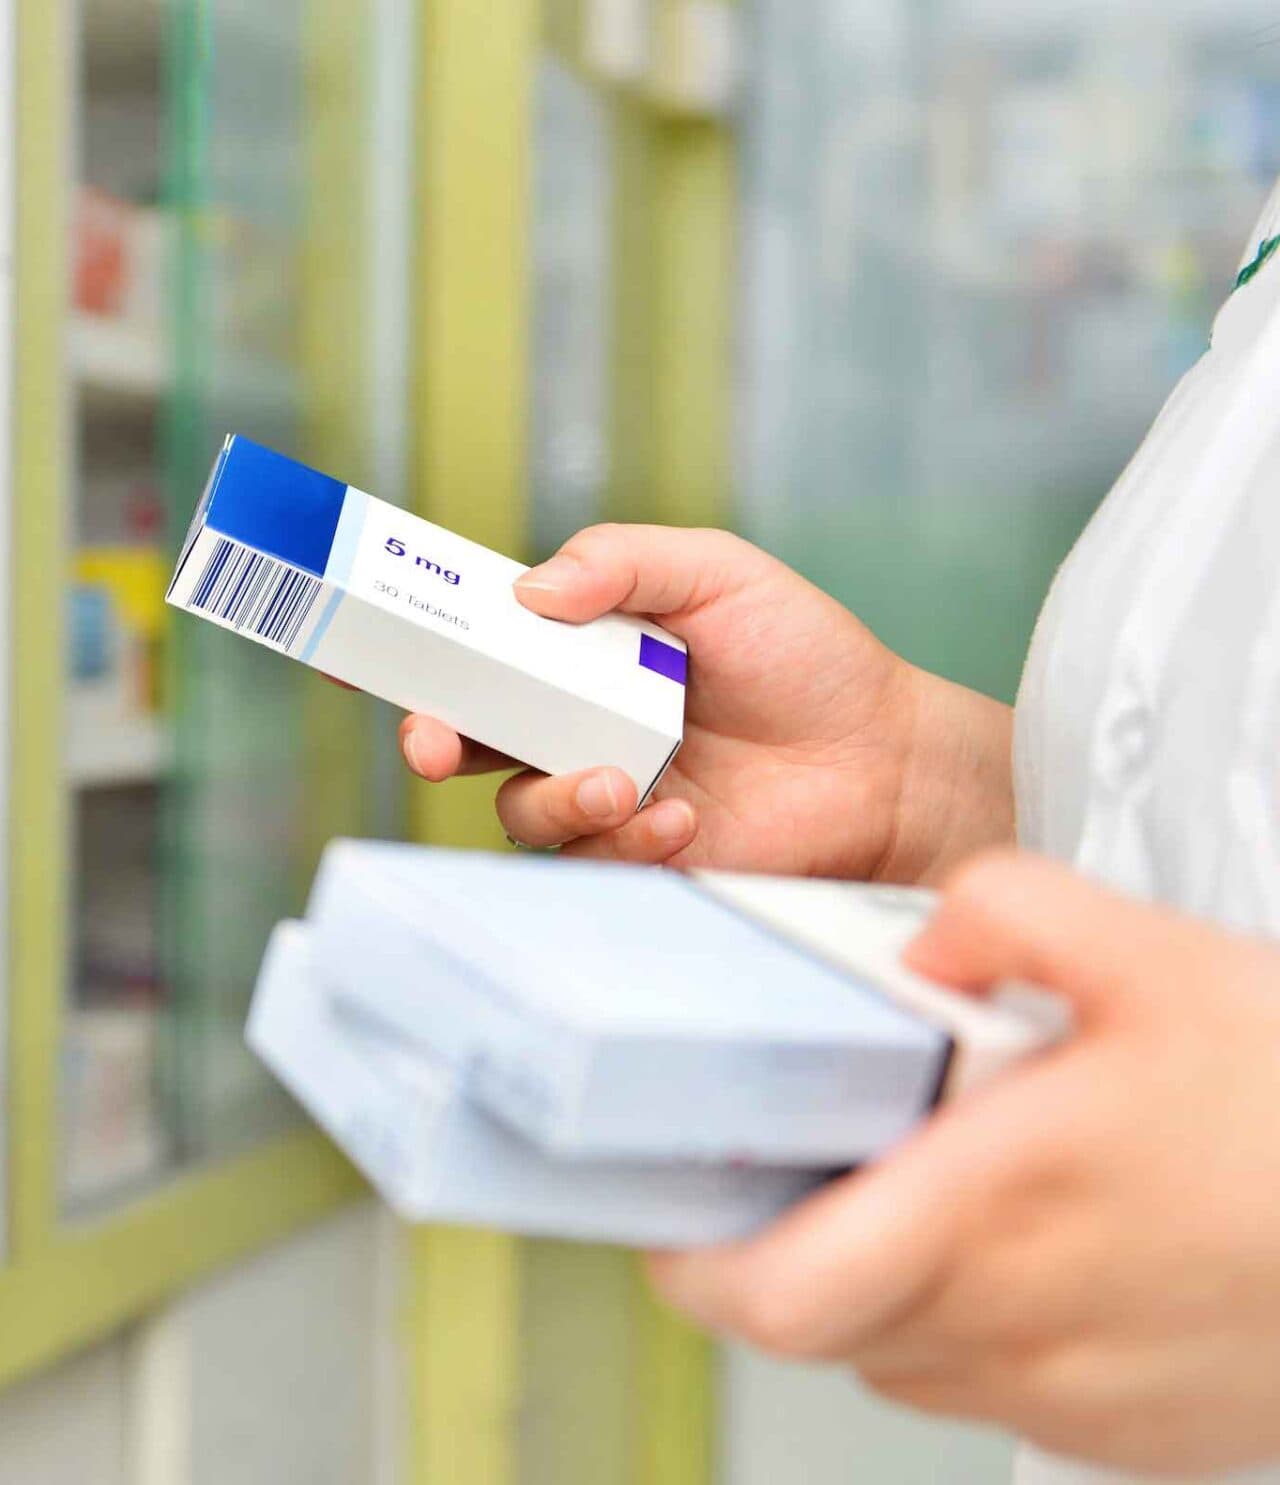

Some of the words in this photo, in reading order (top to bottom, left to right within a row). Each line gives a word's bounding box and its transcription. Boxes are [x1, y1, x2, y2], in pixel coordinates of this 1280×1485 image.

[384, 537, 406, 557] 5
[415, 556, 461, 586] mg
[374, 580, 399, 598] 30
[407, 594, 470, 630] Tablets
